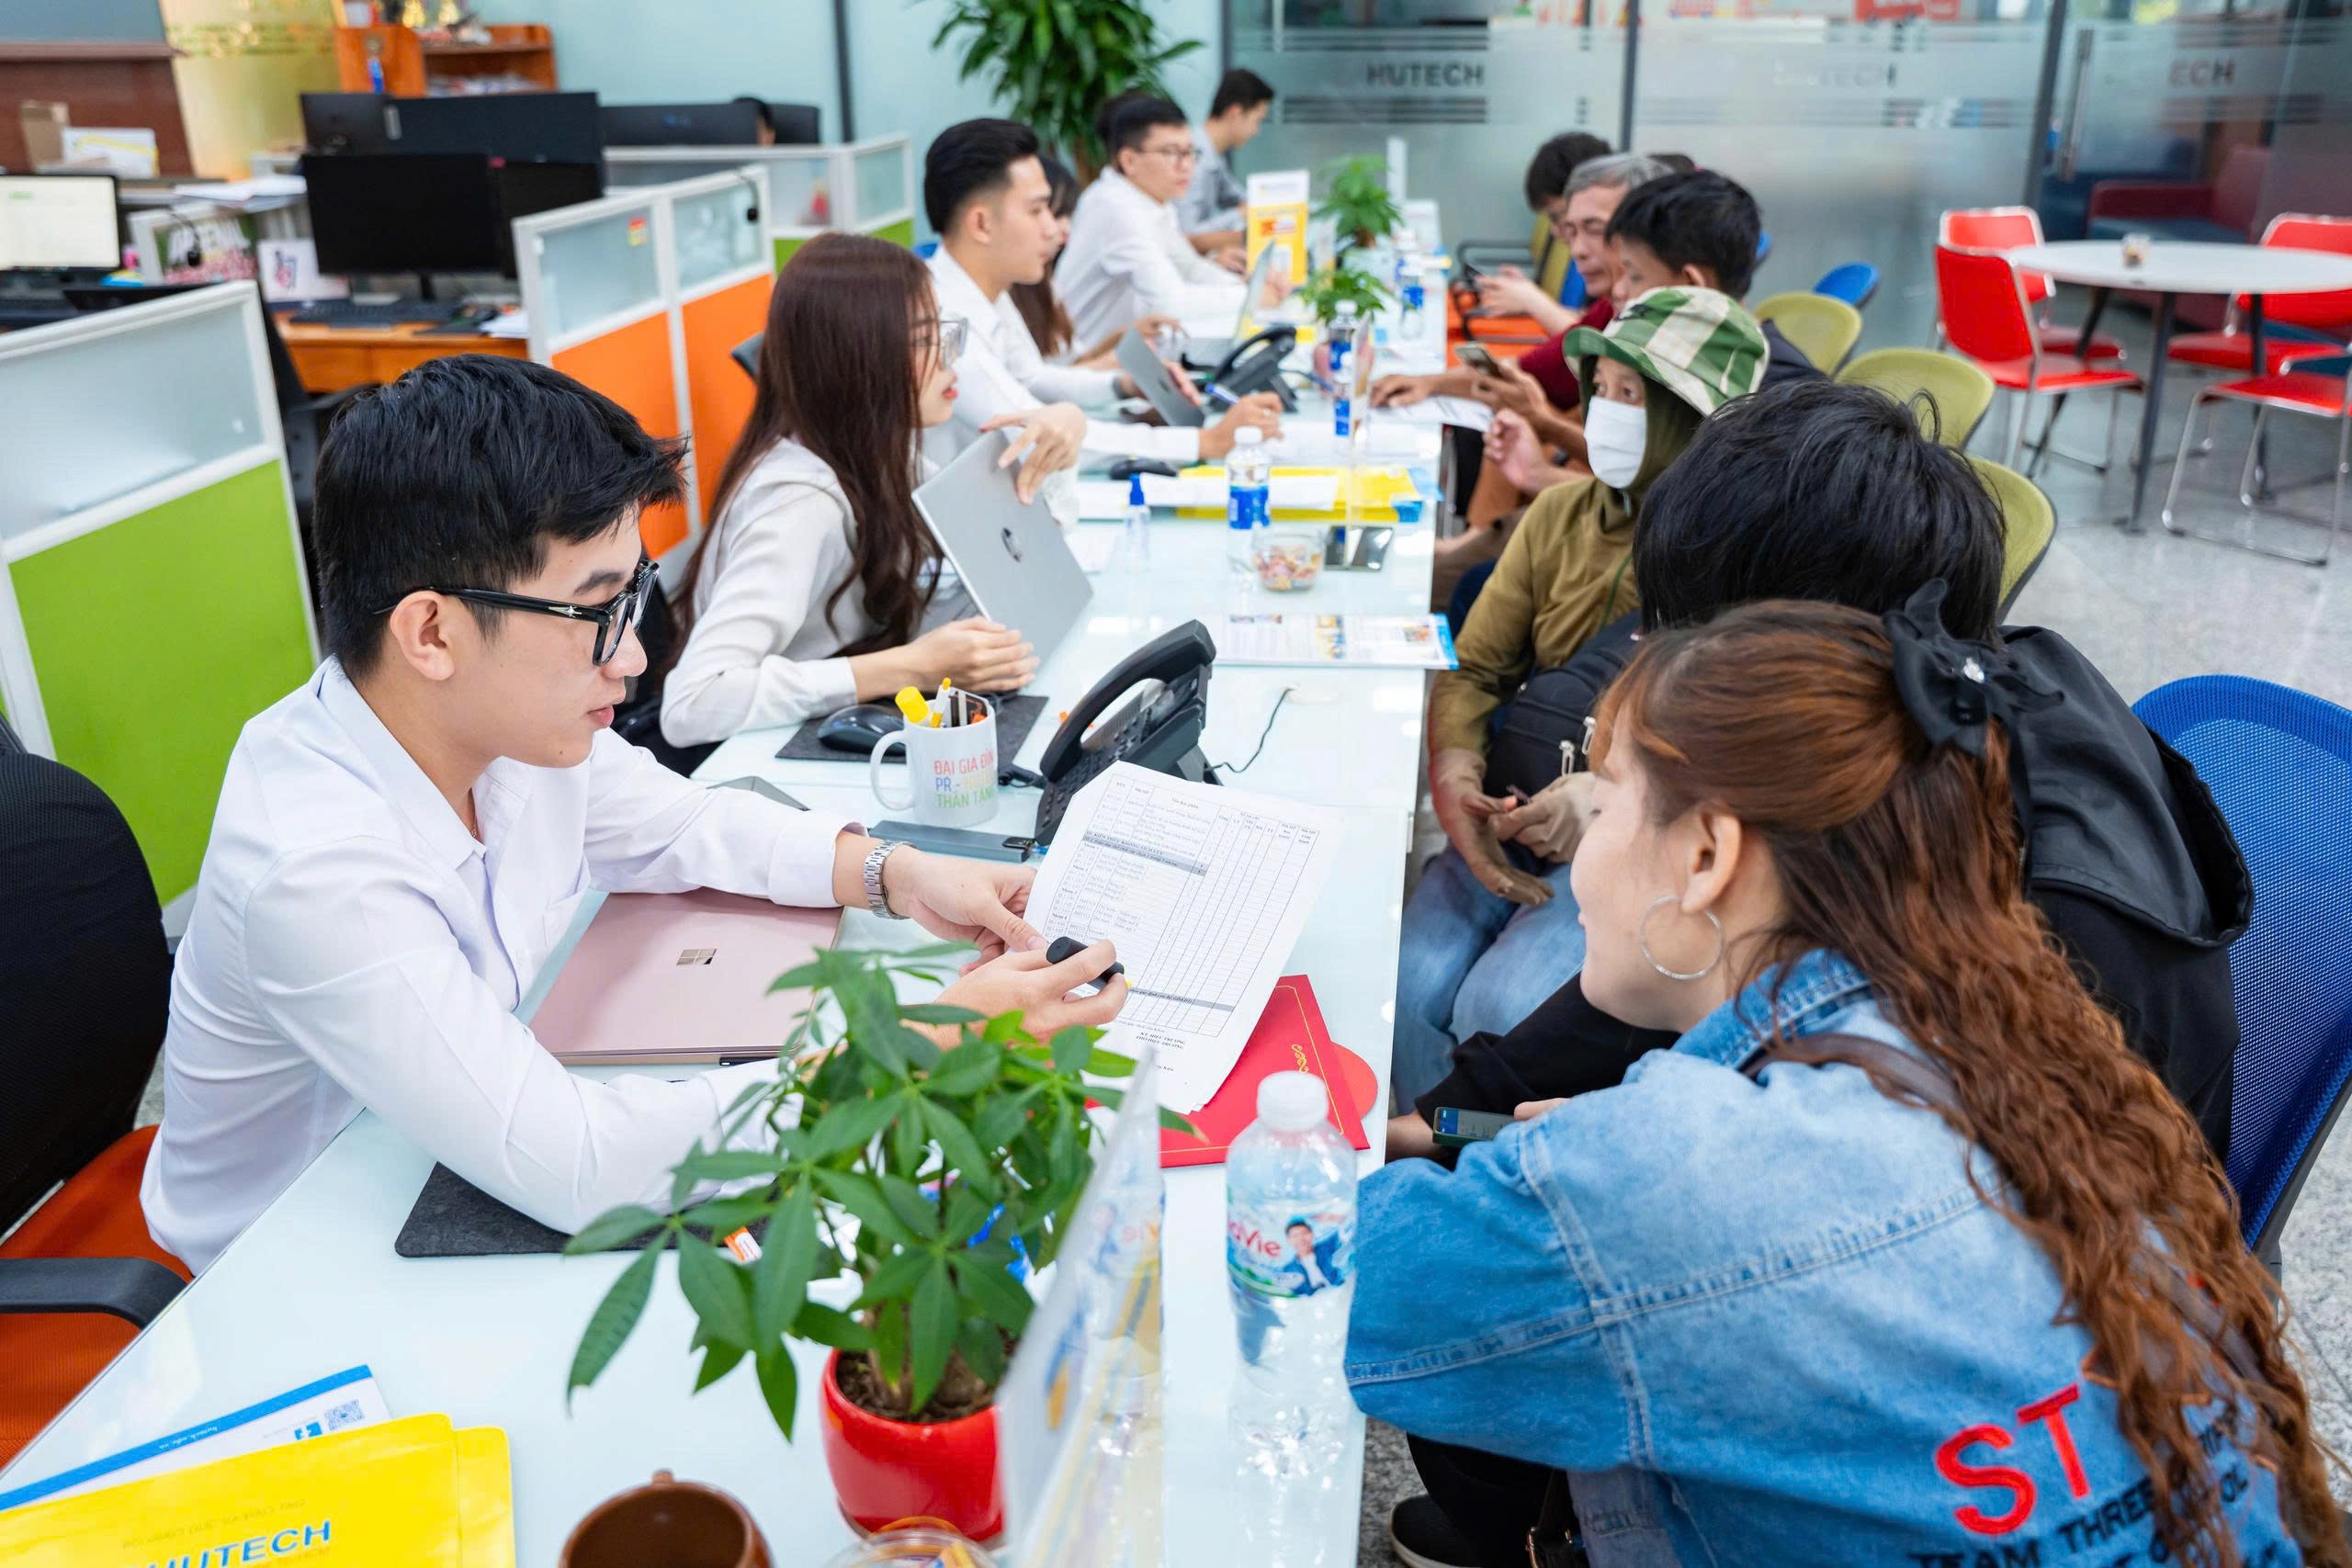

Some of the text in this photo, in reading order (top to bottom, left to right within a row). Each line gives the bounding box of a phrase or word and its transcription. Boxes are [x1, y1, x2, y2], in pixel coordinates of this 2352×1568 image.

[1365, 62, 1485, 88] HUTECH
[958, 756, 978, 774] GIA
[935, 777, 952, 791] PR
[1227, 1222, 1281, 1258] aVie
[147, 1517, 332, 1568] UTECH
